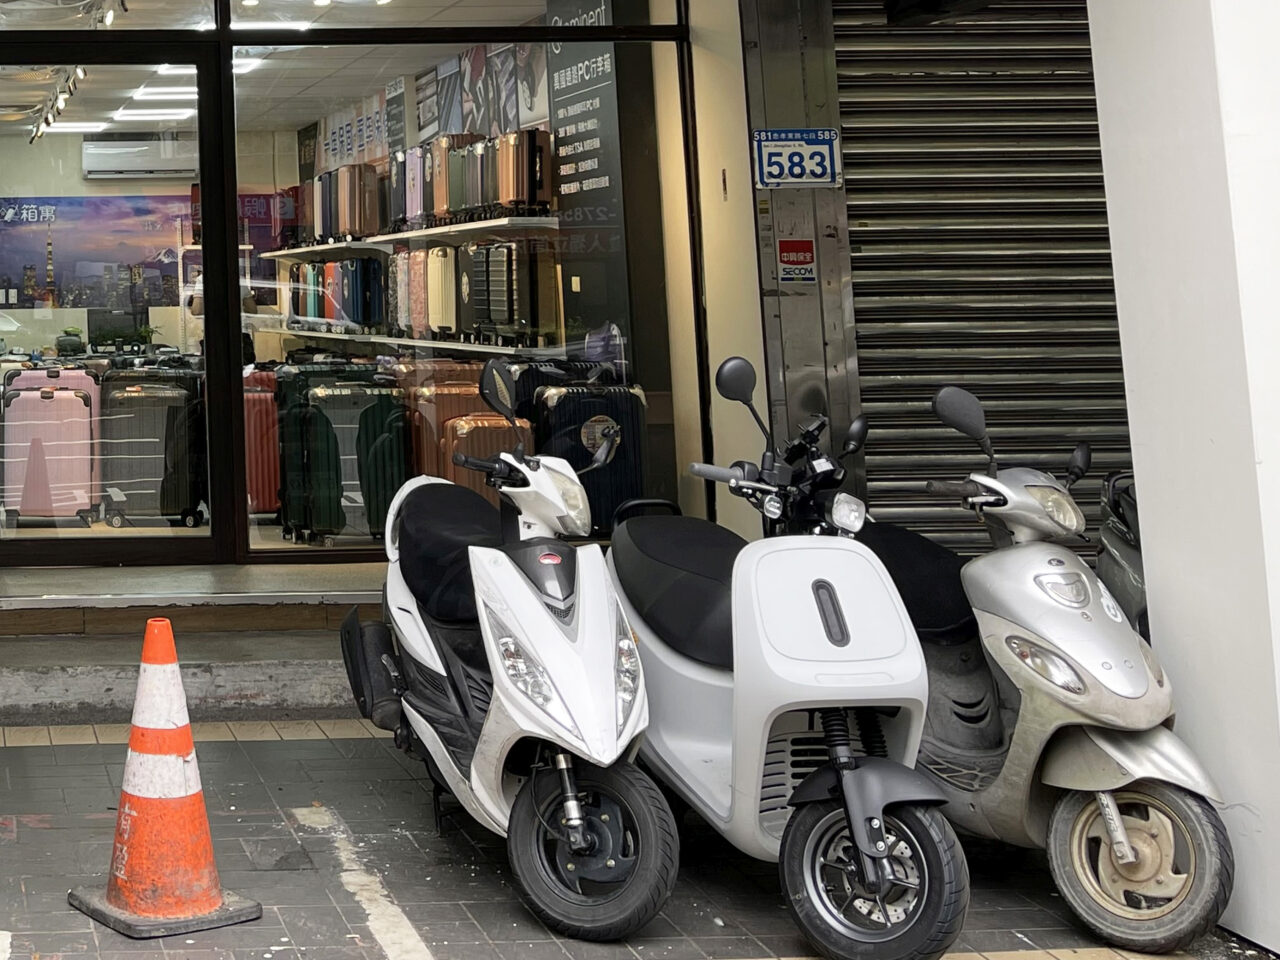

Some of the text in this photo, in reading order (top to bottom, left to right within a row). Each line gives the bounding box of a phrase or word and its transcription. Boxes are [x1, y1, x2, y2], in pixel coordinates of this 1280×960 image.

[753, 131, 771, 140] 581
[817, 131, 837, 139] 585
[767, 151, 827, 179] 583
[20, 204, 56, 222] 箱寓
[782, 267, 813, 276] SECOM
